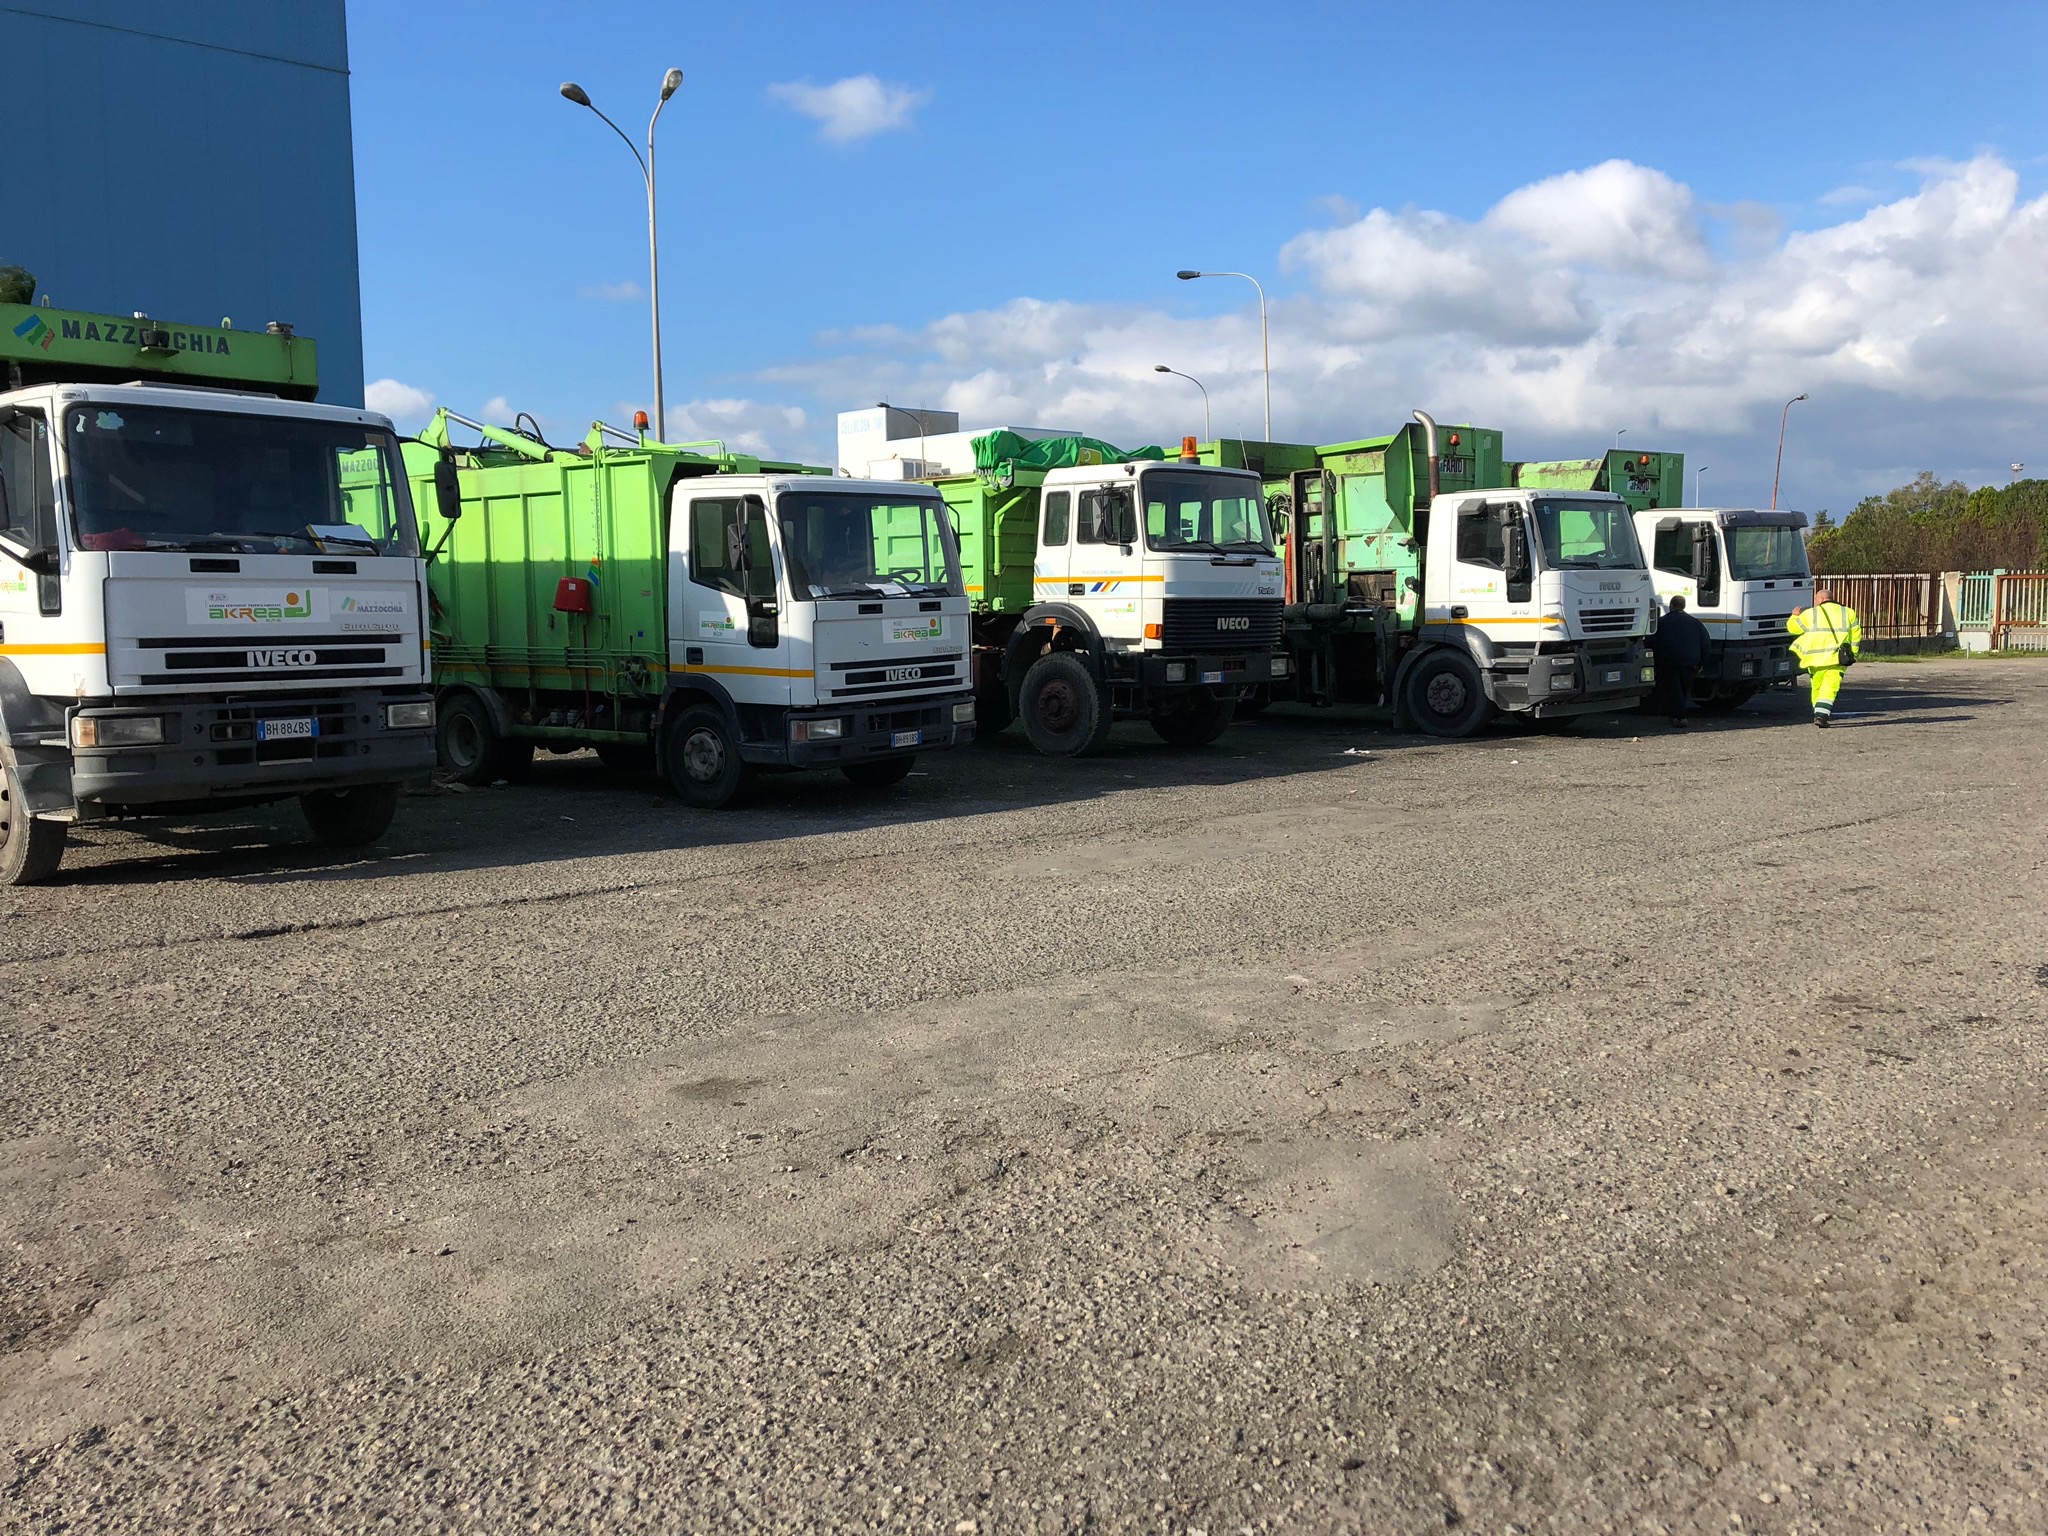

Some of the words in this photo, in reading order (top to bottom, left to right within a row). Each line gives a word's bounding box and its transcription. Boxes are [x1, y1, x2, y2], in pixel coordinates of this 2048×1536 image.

[61, 318, 231, 355] MAZZCHIA
[341, 458, 379, 473] MAZZOC
[356, 605, 403, 613] MAZZOCCHIA
[1578, 597, 1640, 606] STRALIS
[1216, 617, 1250, 630] IVECO
[246, 649, 317, 667] IVECO
[885, 667, 922, 682] IVECO
